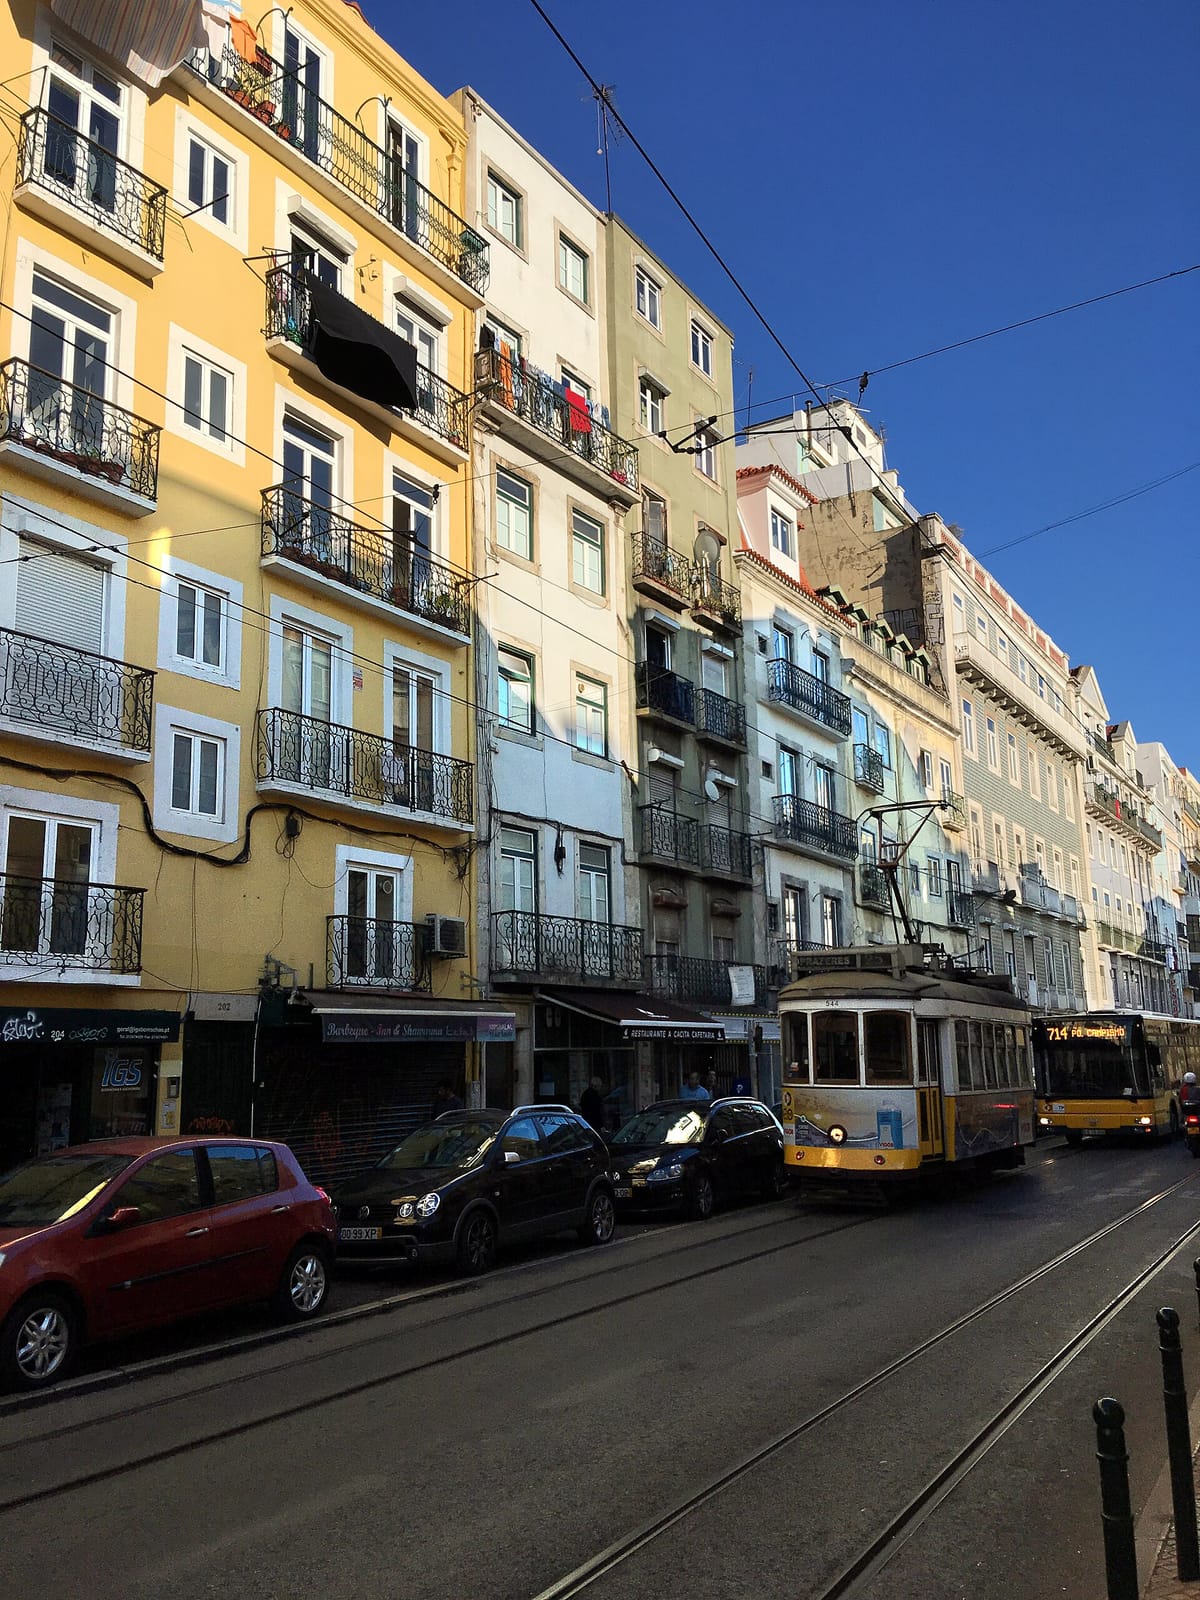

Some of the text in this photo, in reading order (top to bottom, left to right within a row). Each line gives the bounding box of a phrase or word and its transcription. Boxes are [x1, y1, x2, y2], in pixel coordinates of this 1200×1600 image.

[217, 1002, 231, 1011] 202
[50, 1030, 65, 1038] 204
[631, 1029, 666, 1038] RESTAURANTE
[1046, 1026, 1068, 1041] 714
